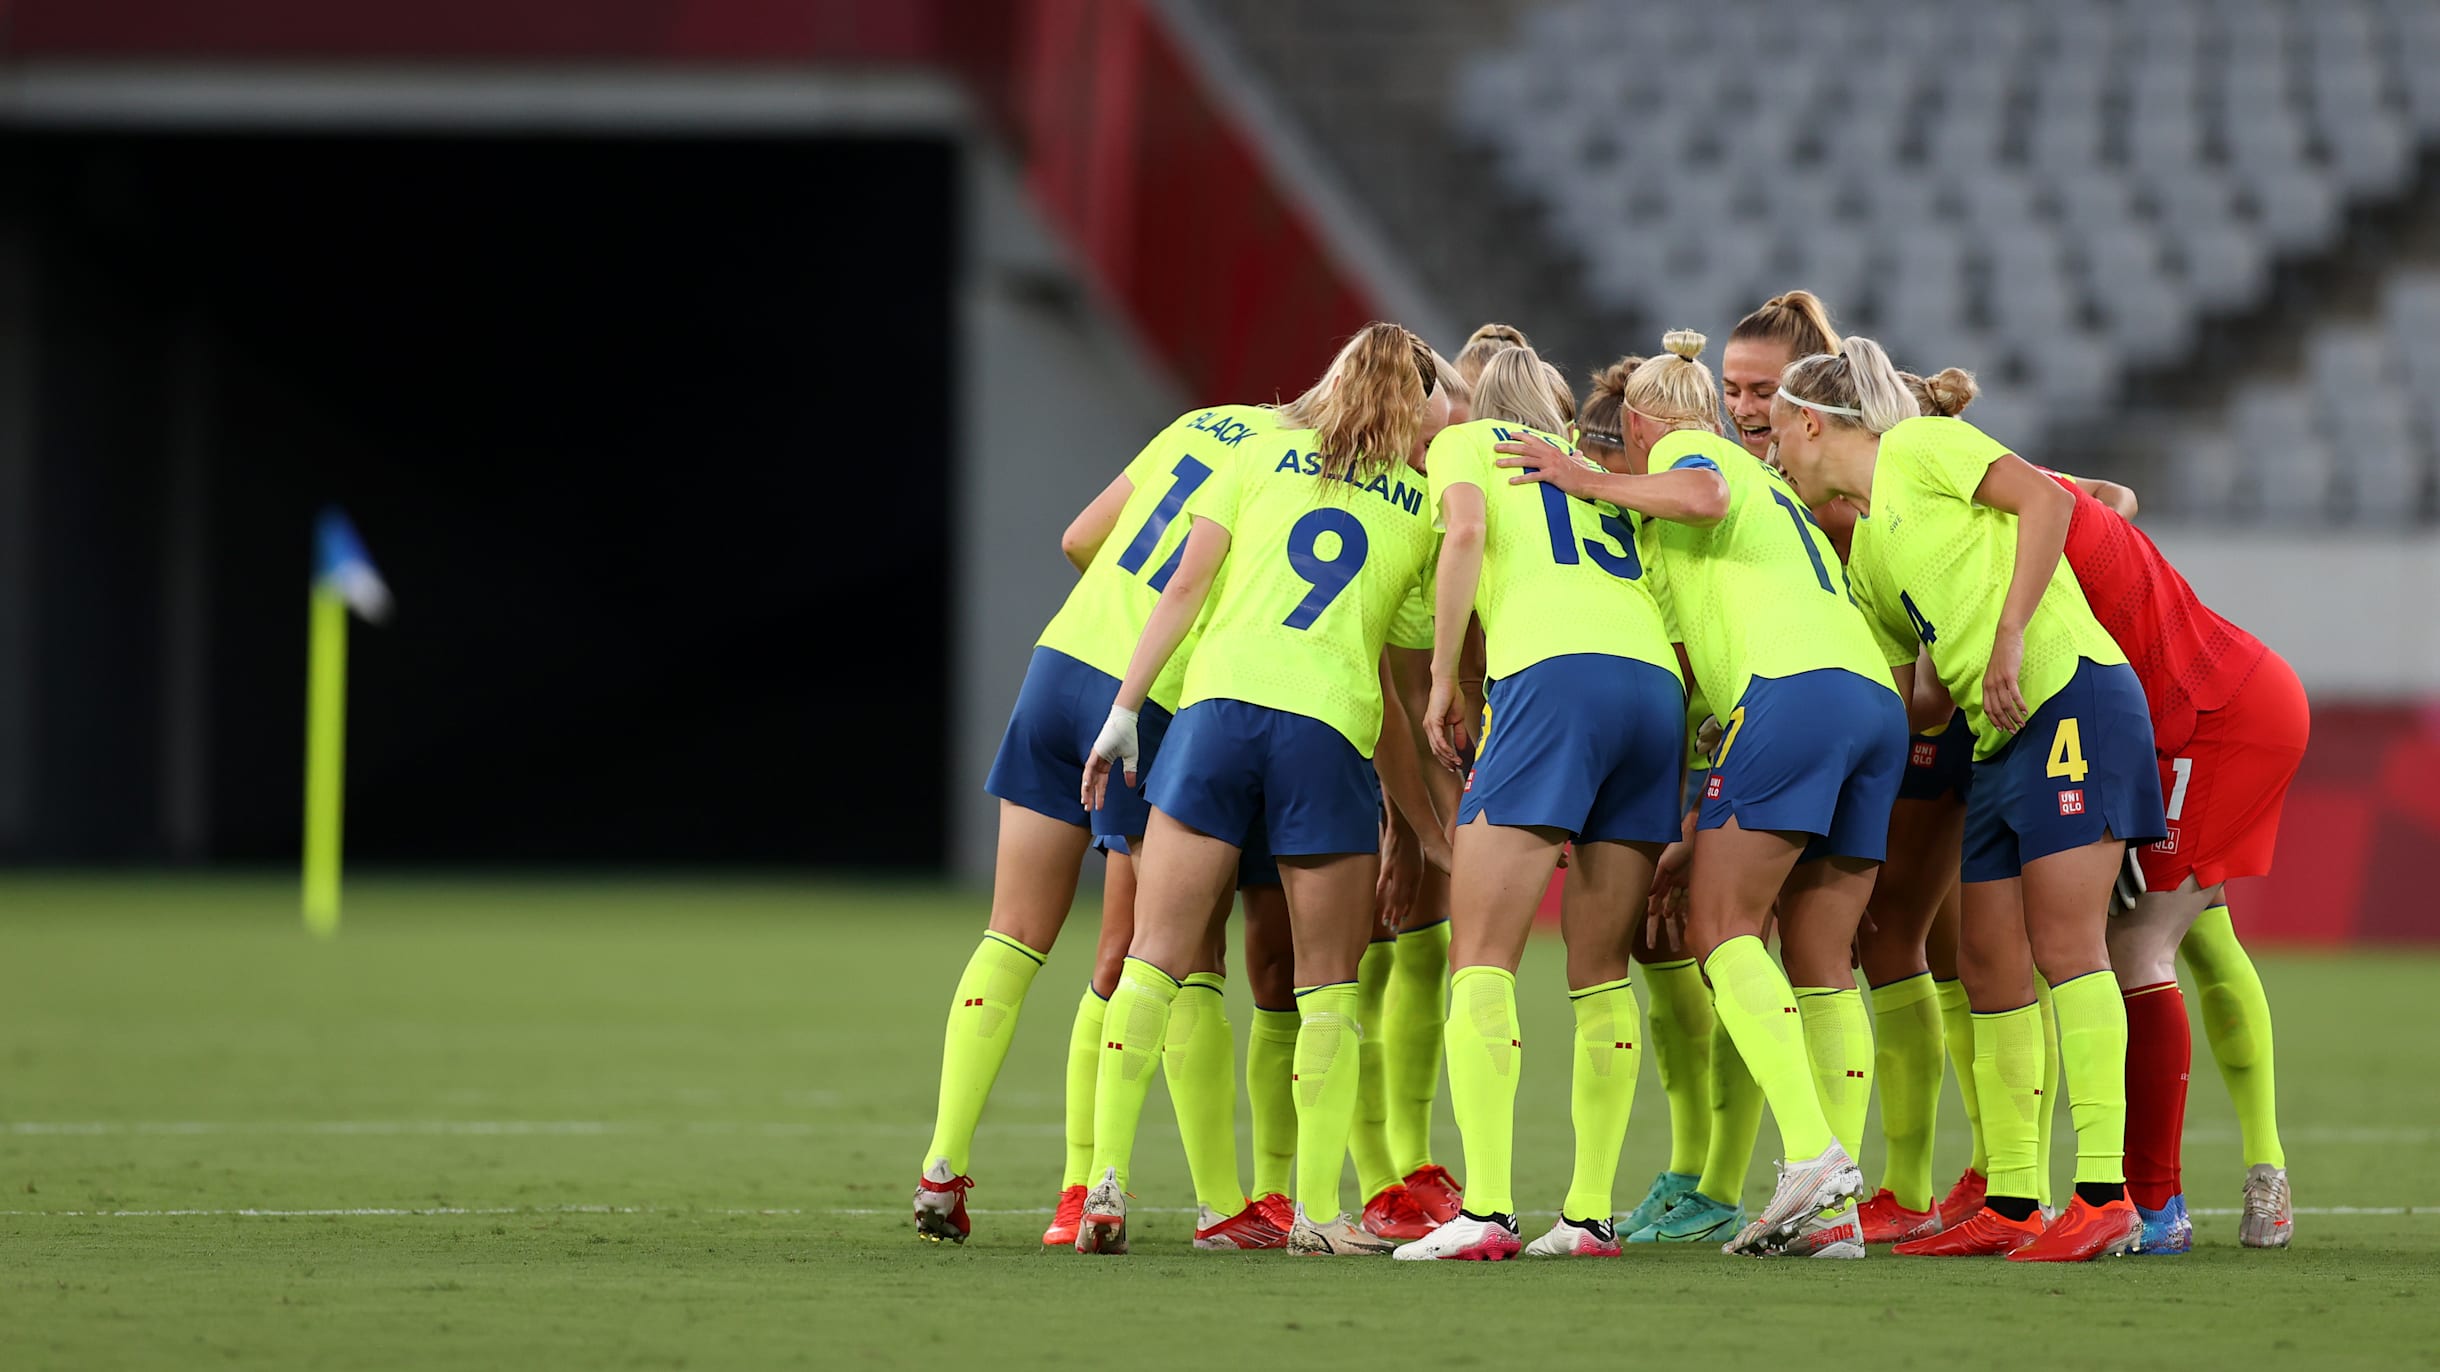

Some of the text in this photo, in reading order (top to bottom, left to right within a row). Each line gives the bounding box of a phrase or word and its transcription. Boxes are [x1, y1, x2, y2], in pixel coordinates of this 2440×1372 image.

[1523, 466, 1643, 581] 13
[1769, 486, 1860, 609] 1
[1282, 507, 1369, 631] 9
[1900, 588, 1938, 648] 4
[1913, 754, 1932, 765] QLO
[1915, 744, 1933, 756] UNI
[2046, 717, 2089, 782] 4
[2061, 792, 2080, 803] UNI
[2062, 801, 2082, 815] QLO
[2166, 757, 2193, 821] 1
